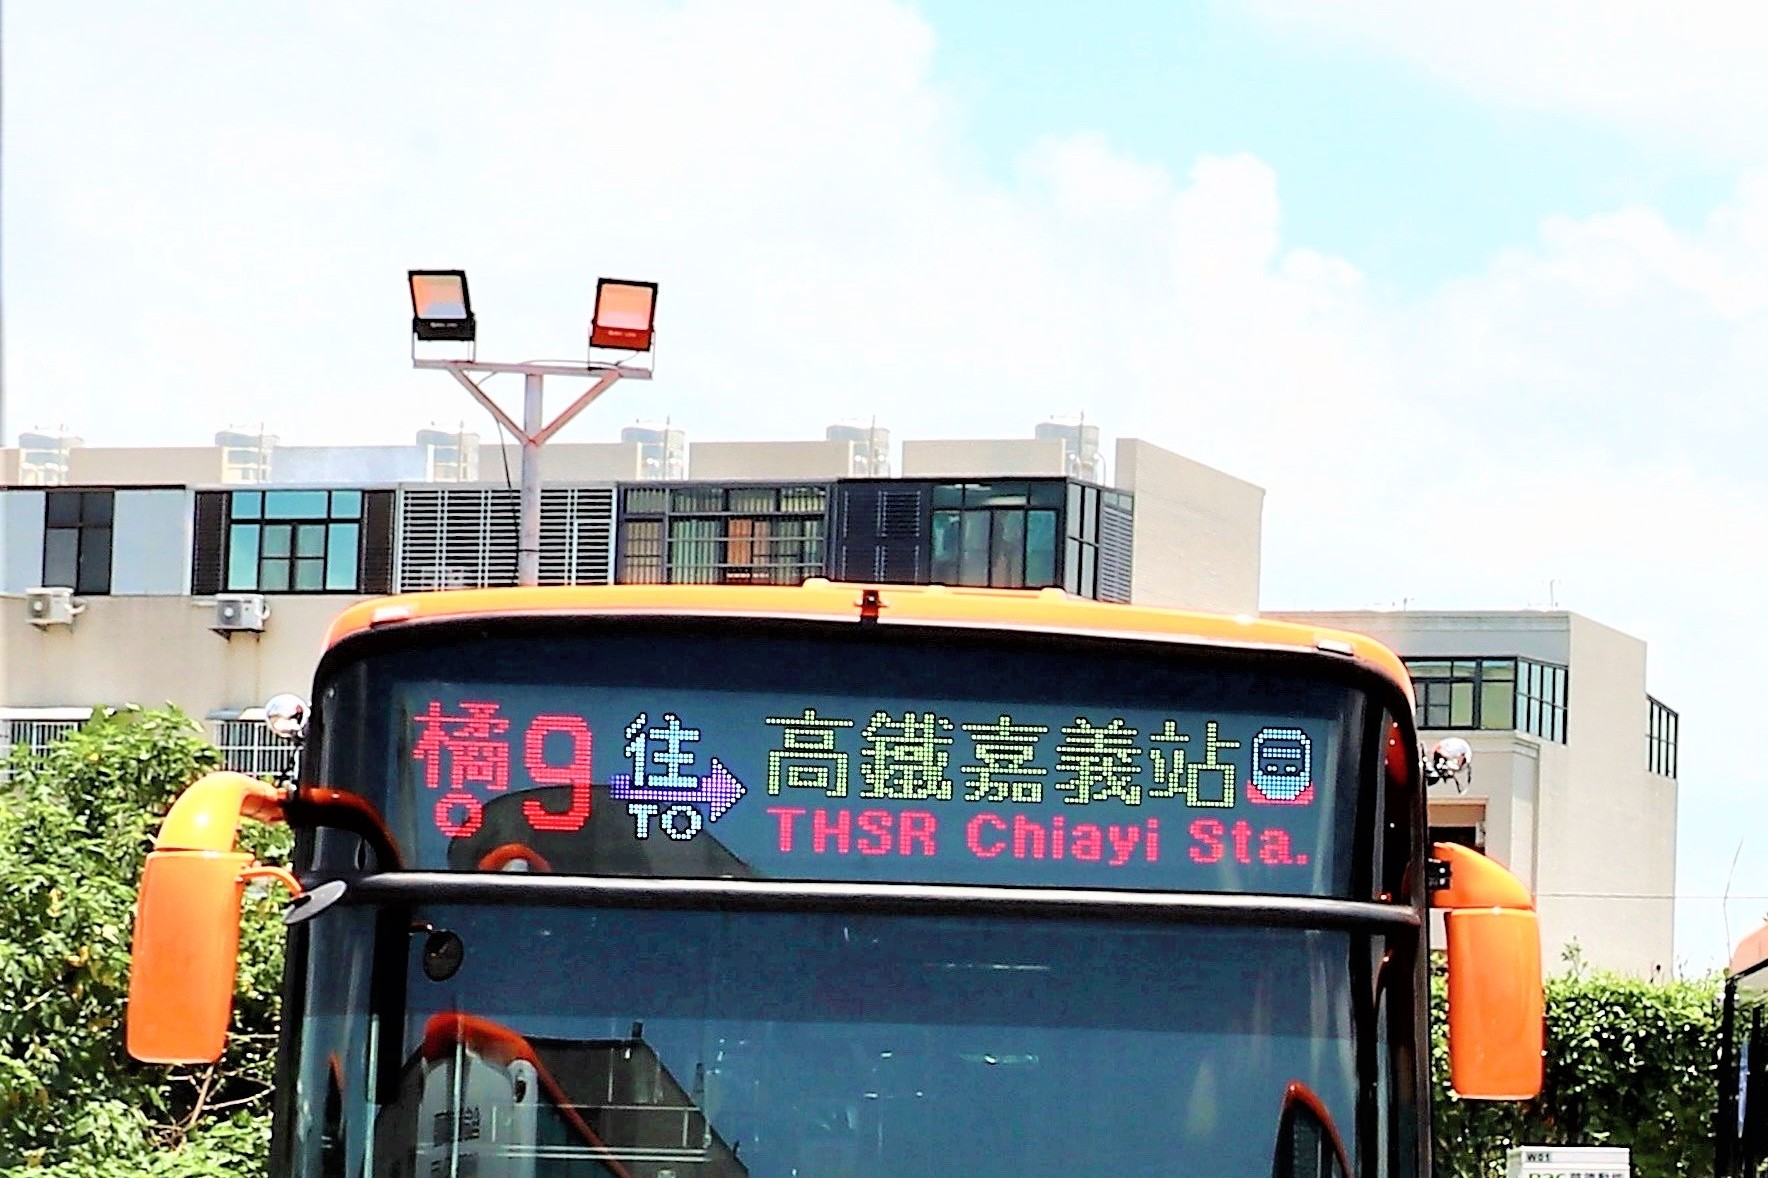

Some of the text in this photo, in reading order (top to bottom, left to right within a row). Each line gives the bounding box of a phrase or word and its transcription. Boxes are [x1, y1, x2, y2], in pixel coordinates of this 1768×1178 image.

[624, 713, 700, 787] 往
[765, 708, 1241, 808] 高鐵嘉義站
[628, 804, 702, 839] TO
[766, 808, 1309, 866] THSR Chiayi Sta.
